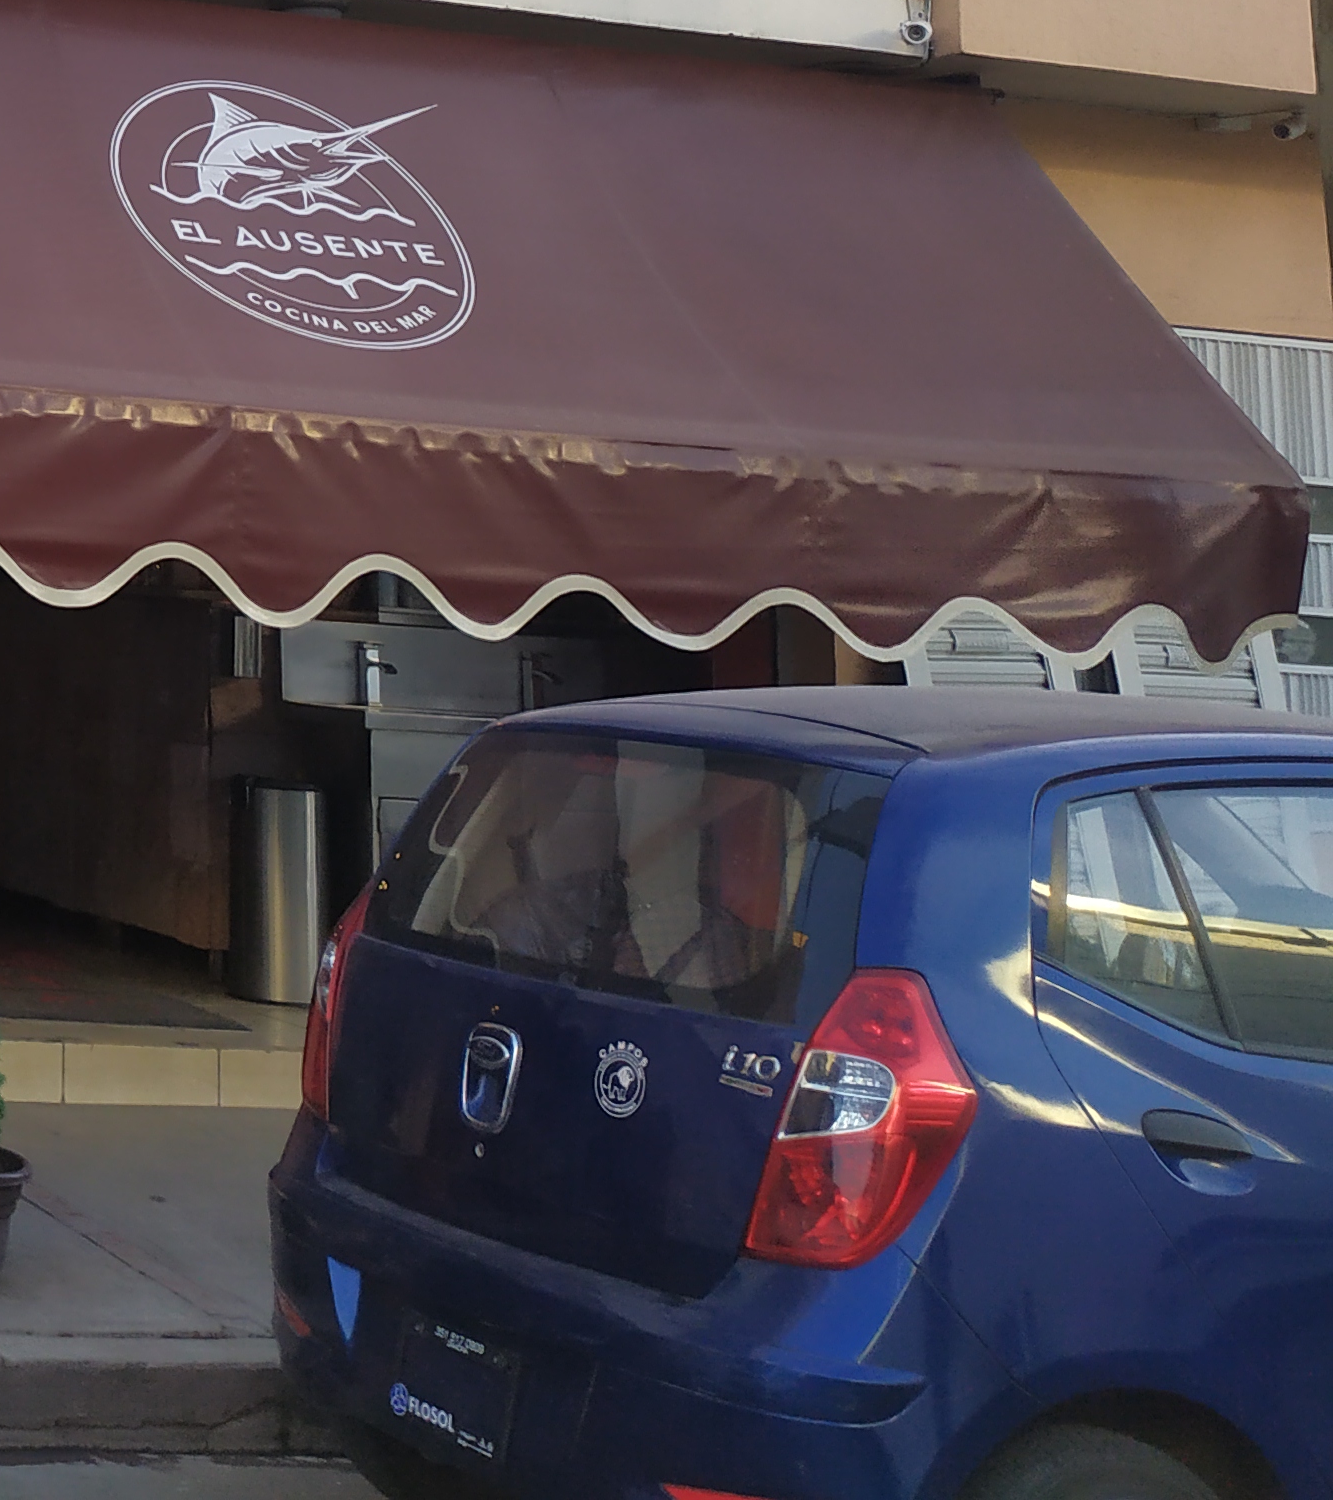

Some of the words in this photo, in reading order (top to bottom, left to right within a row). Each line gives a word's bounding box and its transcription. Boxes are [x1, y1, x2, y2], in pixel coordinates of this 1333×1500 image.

[170, 219, 222, 245] EL
[235, 225, 446, 267] AUSENTE
[246, 290, 349, 333] COCINA
[353, 320, 399, 336] DEL
[395, 303, 439, 332] MAR
[598, 1040, 649, 1068] CAMPOS
[721, 1044, 782, 1081] i10
[408, 1395, 455, 1434] FLOSOL
